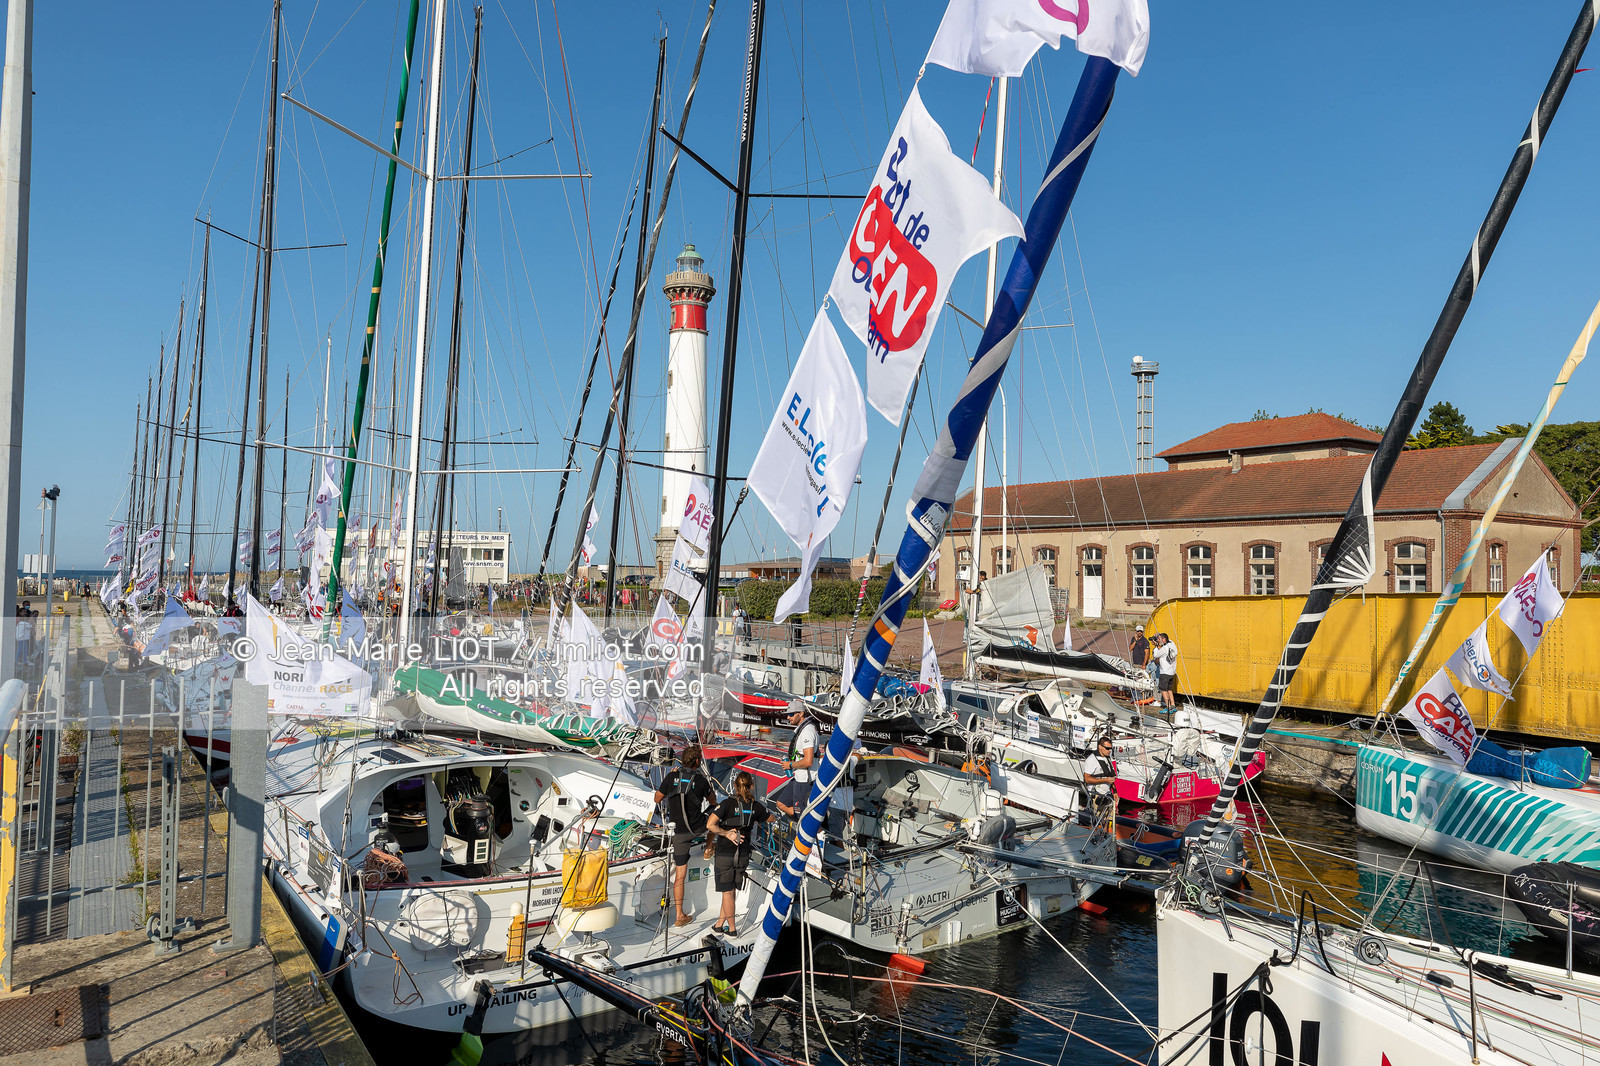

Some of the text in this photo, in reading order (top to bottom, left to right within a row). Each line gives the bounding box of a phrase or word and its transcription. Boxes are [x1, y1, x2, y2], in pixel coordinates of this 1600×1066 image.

[903, 211, 930, 250] de
[856, 199, 927, 338] CEN
[319, 684, 354, 693] RACE
[1360, 762, 1384, 775] CORUM
[620, 793, 650, 809] PURE OCEAN
[1203, 840, 1229, 852] AMAHA
[687, 953, 704, 964] UP
[447, 989, 537, 1017] UP AILING
